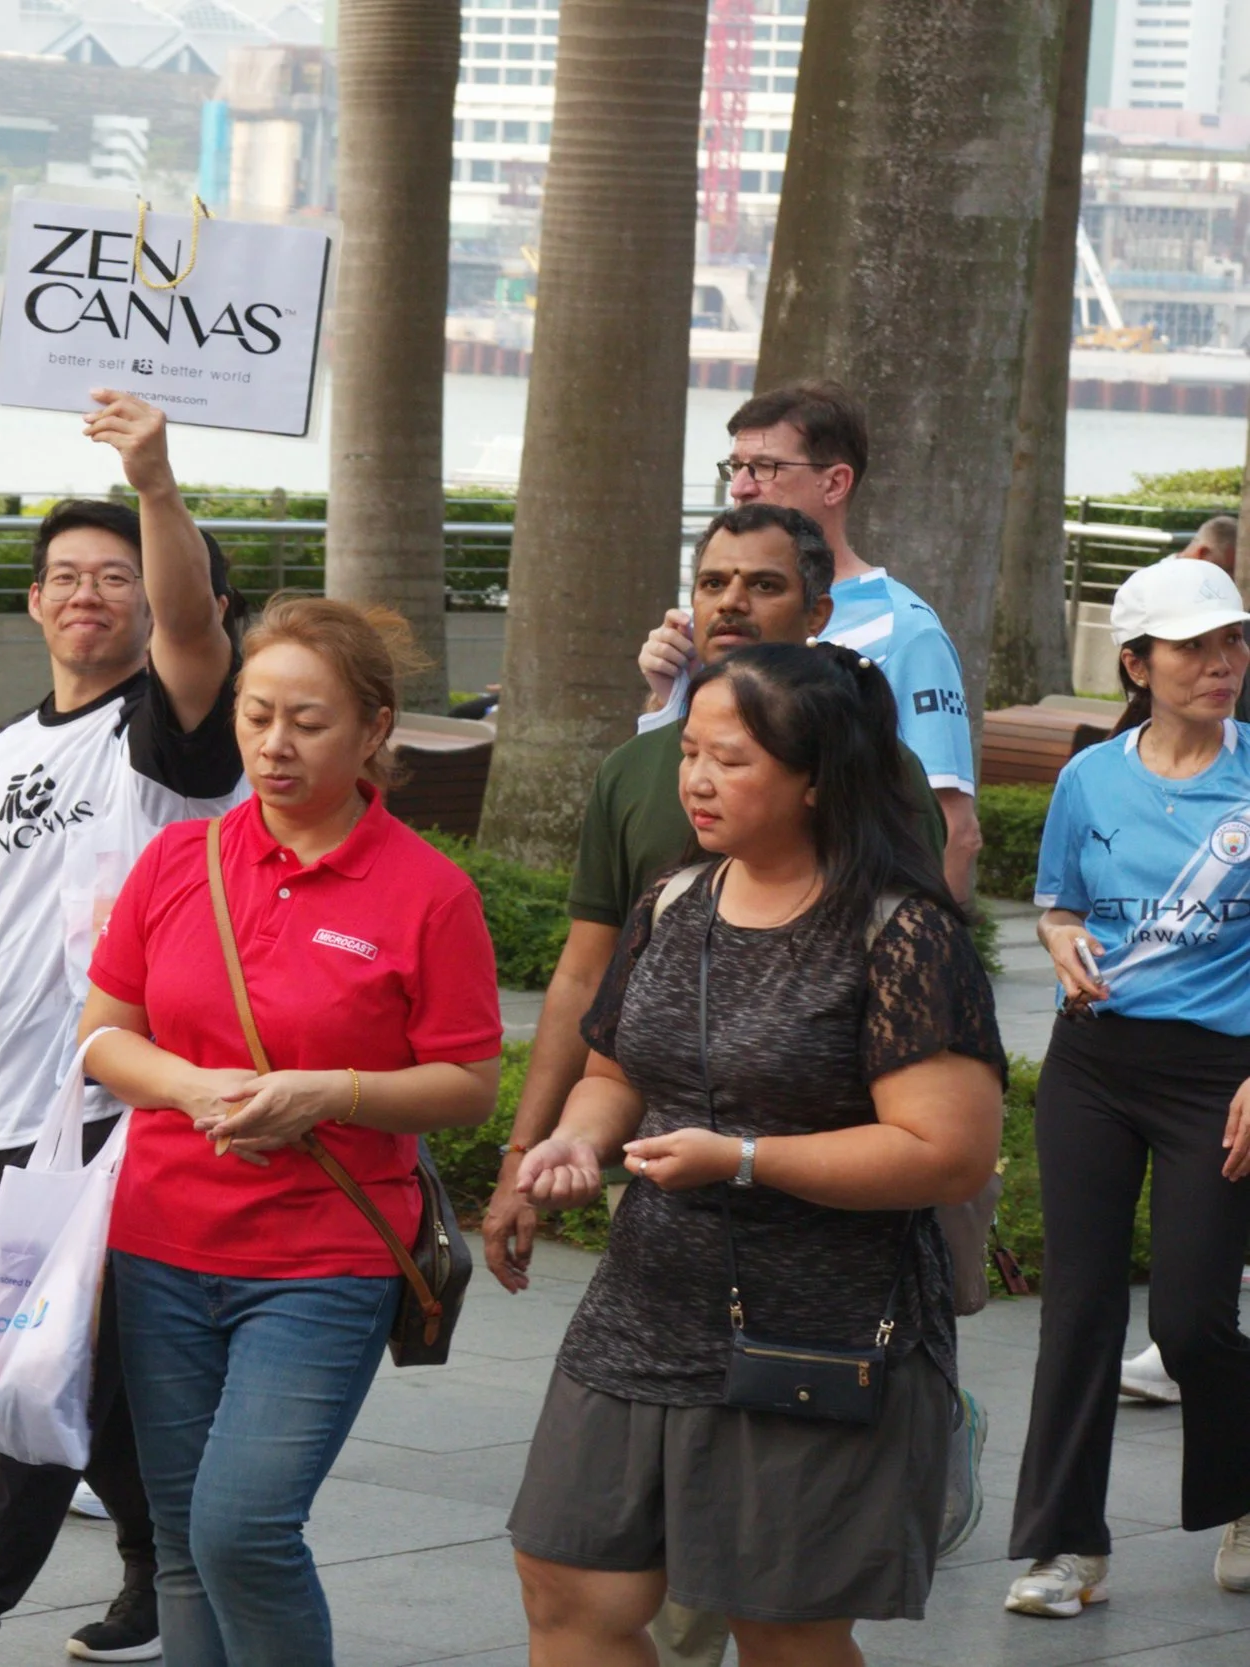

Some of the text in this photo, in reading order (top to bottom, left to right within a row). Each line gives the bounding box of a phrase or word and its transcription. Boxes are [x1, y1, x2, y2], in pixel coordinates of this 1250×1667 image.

[29, 224, 182, 289] ZEN
[24, 282, 283, 355] CANVAS
[49, 352, 251, 384] better self better world
[1093, 898, 1250, 923] ETIHAD
[317, 931, 374, 955] MICROCAST
